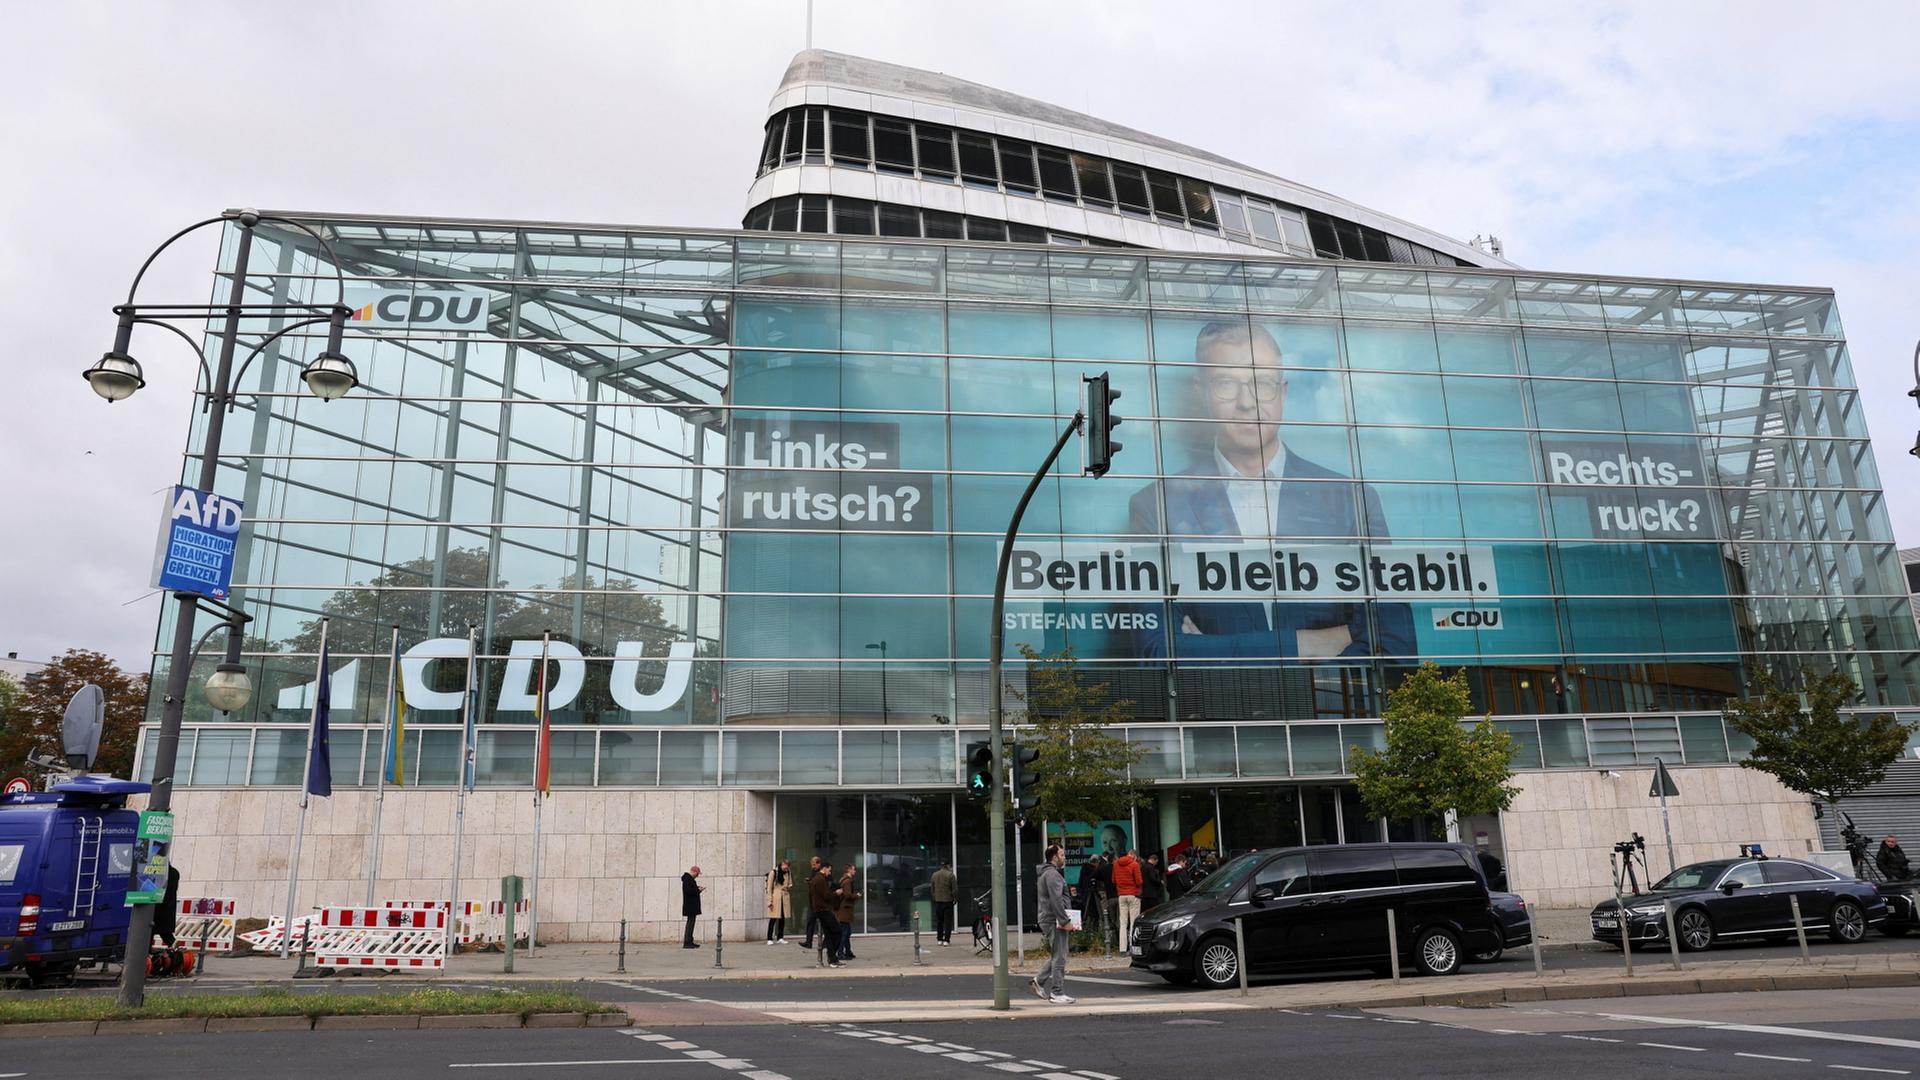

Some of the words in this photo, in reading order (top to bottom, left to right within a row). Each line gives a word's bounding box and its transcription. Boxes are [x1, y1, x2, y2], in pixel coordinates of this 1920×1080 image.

[377, 294, 483, 324] CDU
[744, 430, 887, 470] Links-
[1549, 451, 1693, 486] Rechts-
[172, 489, 243, 534] AfD
[743, 485, 921, 522] rutsch?
[1598, 499, 1700, 532] ruck?
[172, 544, 221, 567] BRAUCHT
[175, 527, 231, 552] MIGRATION
[168, 561, 219, 584] GRENZEN.
[1012, 549, 1180, 601] Berlin,
[1196, 550, 1318, 592] bleib
[1335, 551, 1488, 592] stabil.
[1005, 612, 1087, 630] STEFAN
[1091, 612, 1159, 630] EVERS
[1451, 610, 1499, 627] CDU
[401, 637, 696, 712] CDU
